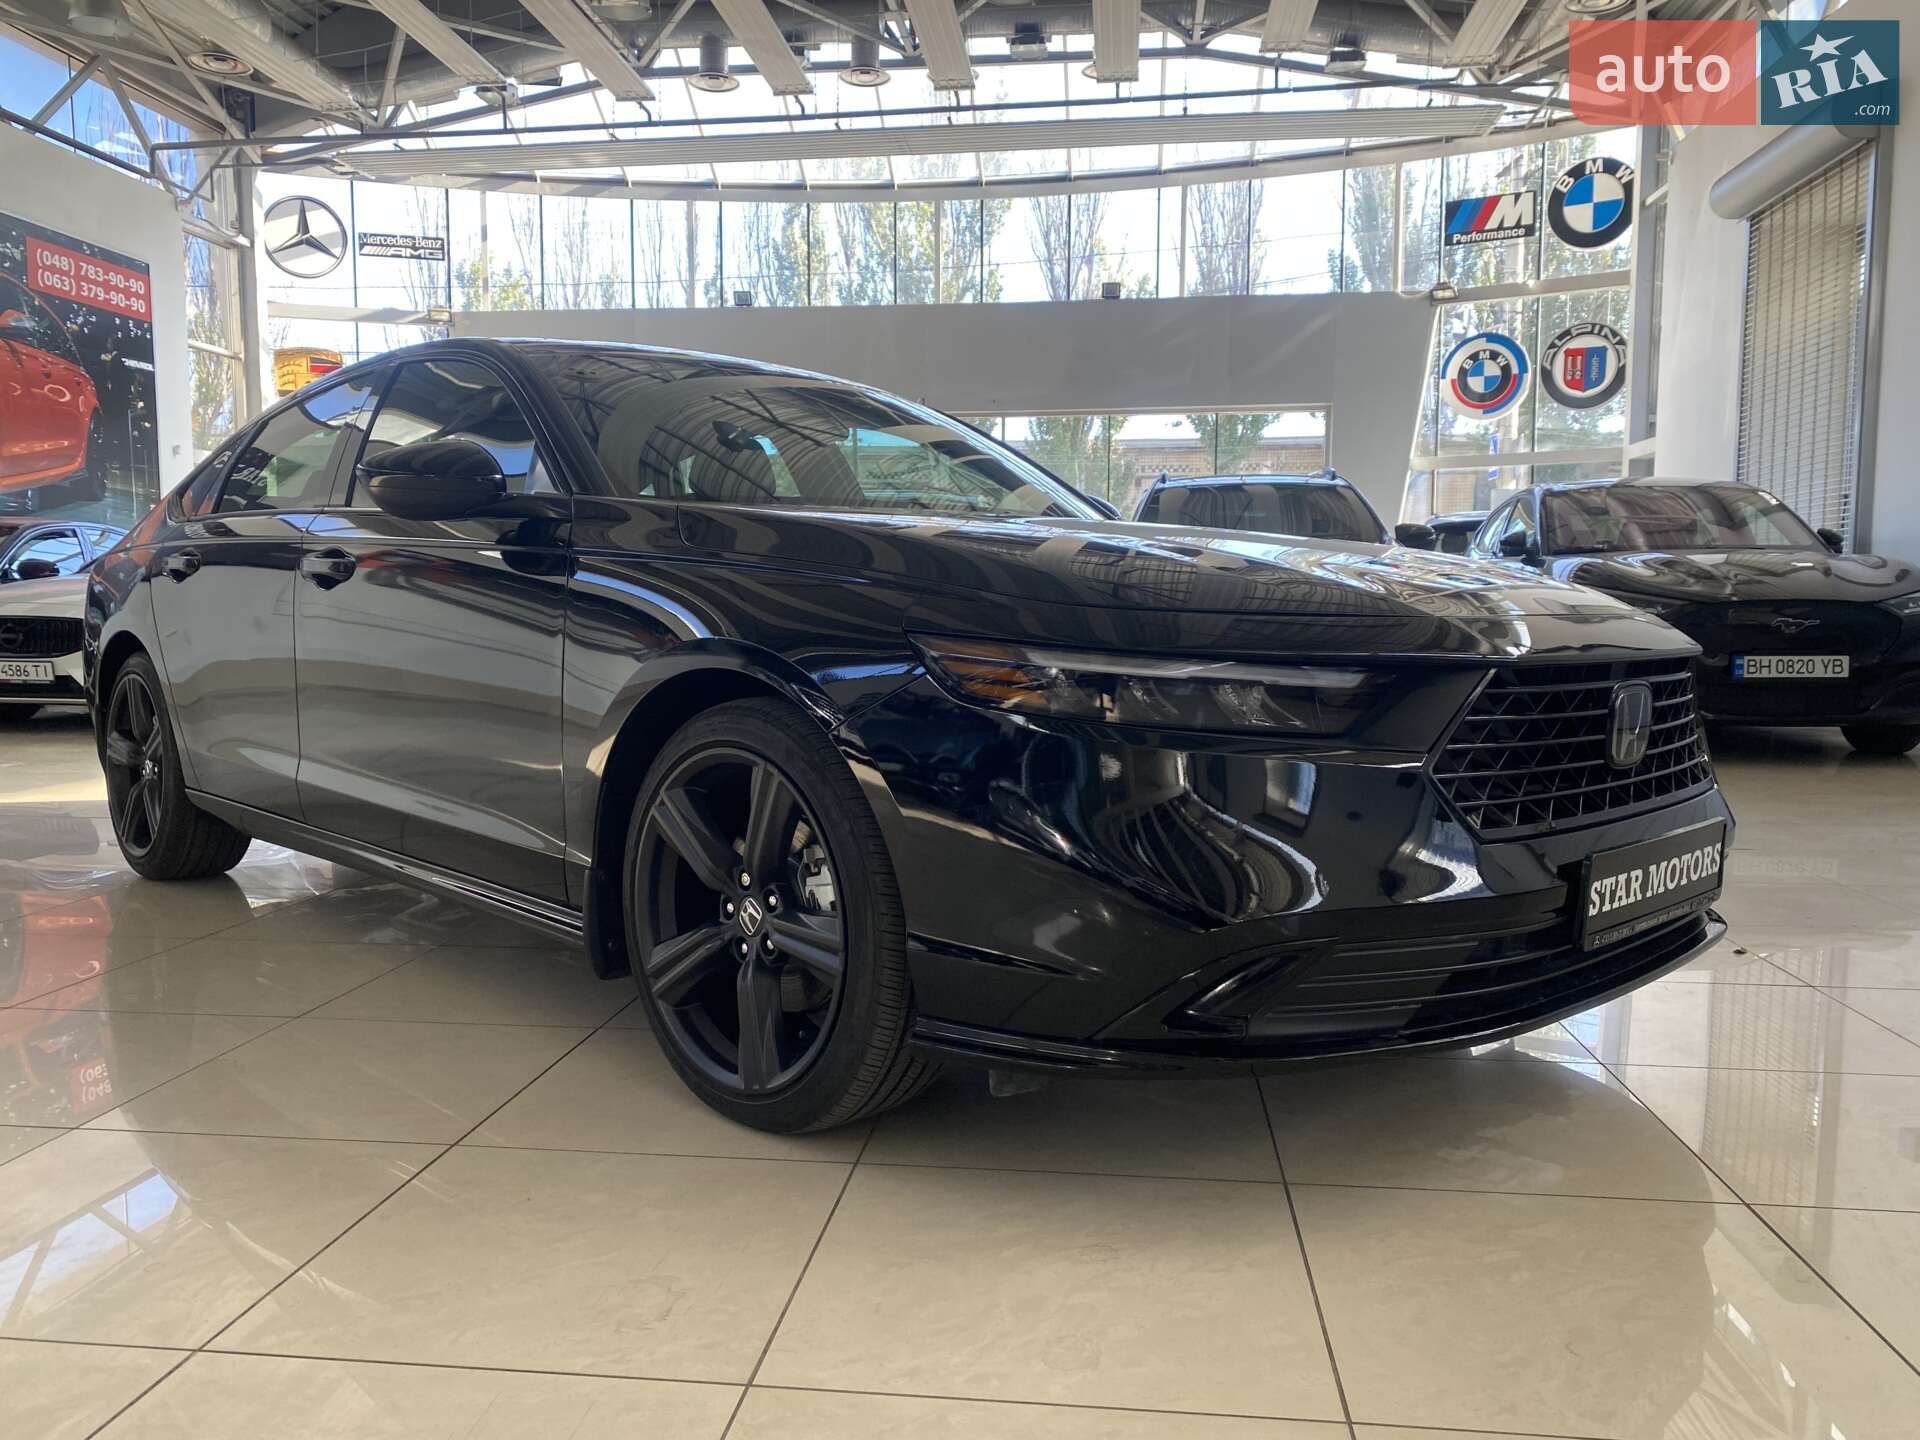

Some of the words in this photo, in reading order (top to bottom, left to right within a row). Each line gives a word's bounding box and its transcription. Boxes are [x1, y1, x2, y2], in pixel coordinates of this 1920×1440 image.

[1556, 159, 1634, 194] BMW
[360, 232, 442, 249] Mercedes-Benz
[1453, 227, 1526, 244] Performance
[386, 246, 444, 259] AMG
[36, 248, 75, 276] (048)
[79, 262, 145, 295] 783-90-90
[37, 268, 76, 296] (063)
[80, 282, 146, 313] 379-90-90
[1543, 323, 1627, 370] ALPINA
[1462, 350, 1508, 370] BMW
[0, 664, 30, 678] 4586
[1746, 658, 1772, 675] BH
[1775, 658, 1815, 675] 0820
[1821, 658, 1845, 675] YB
[1588, 868, 1643, 917] STAR
[1646, 842, 1722, 898] MOTORS
